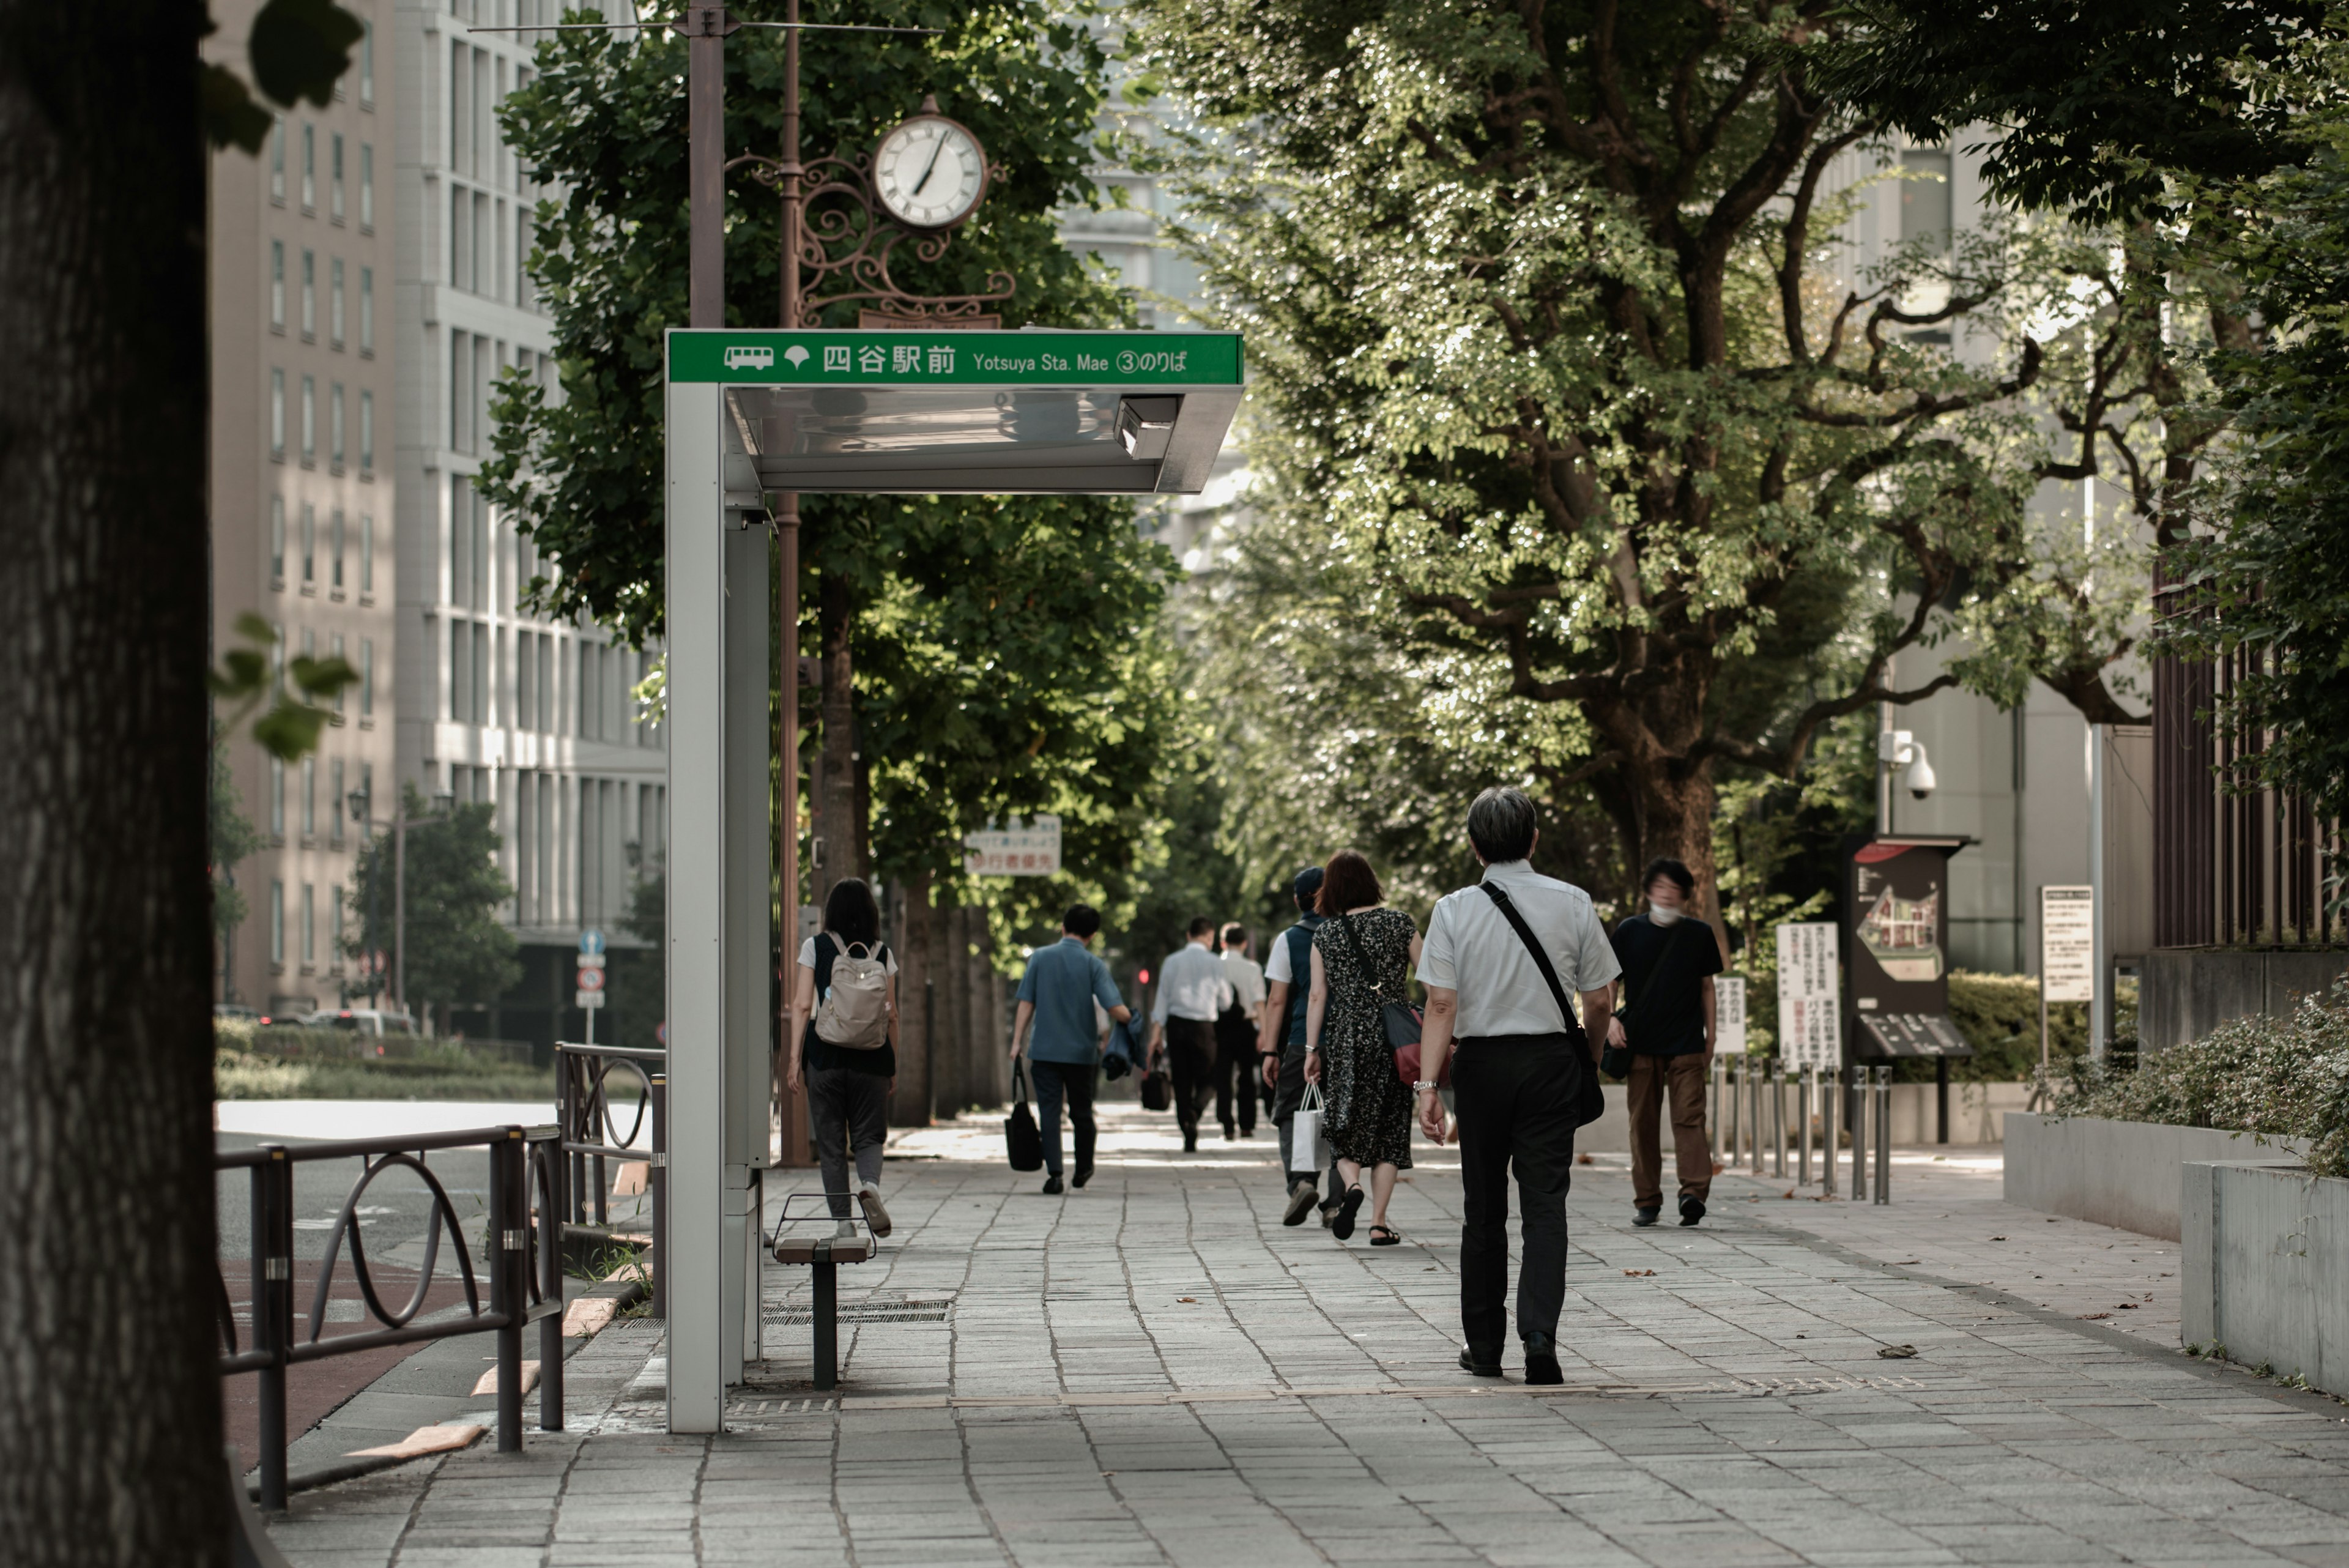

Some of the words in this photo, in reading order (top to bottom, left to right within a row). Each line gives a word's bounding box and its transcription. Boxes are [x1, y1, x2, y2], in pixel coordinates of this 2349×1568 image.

[823, 345, 956, 374] 四谷駅前
[973, 353, 1036, 374] Yotsuya
[1041, 353, 1071, 371] Sta.
[1077, 354, 1109, 371] Mae
